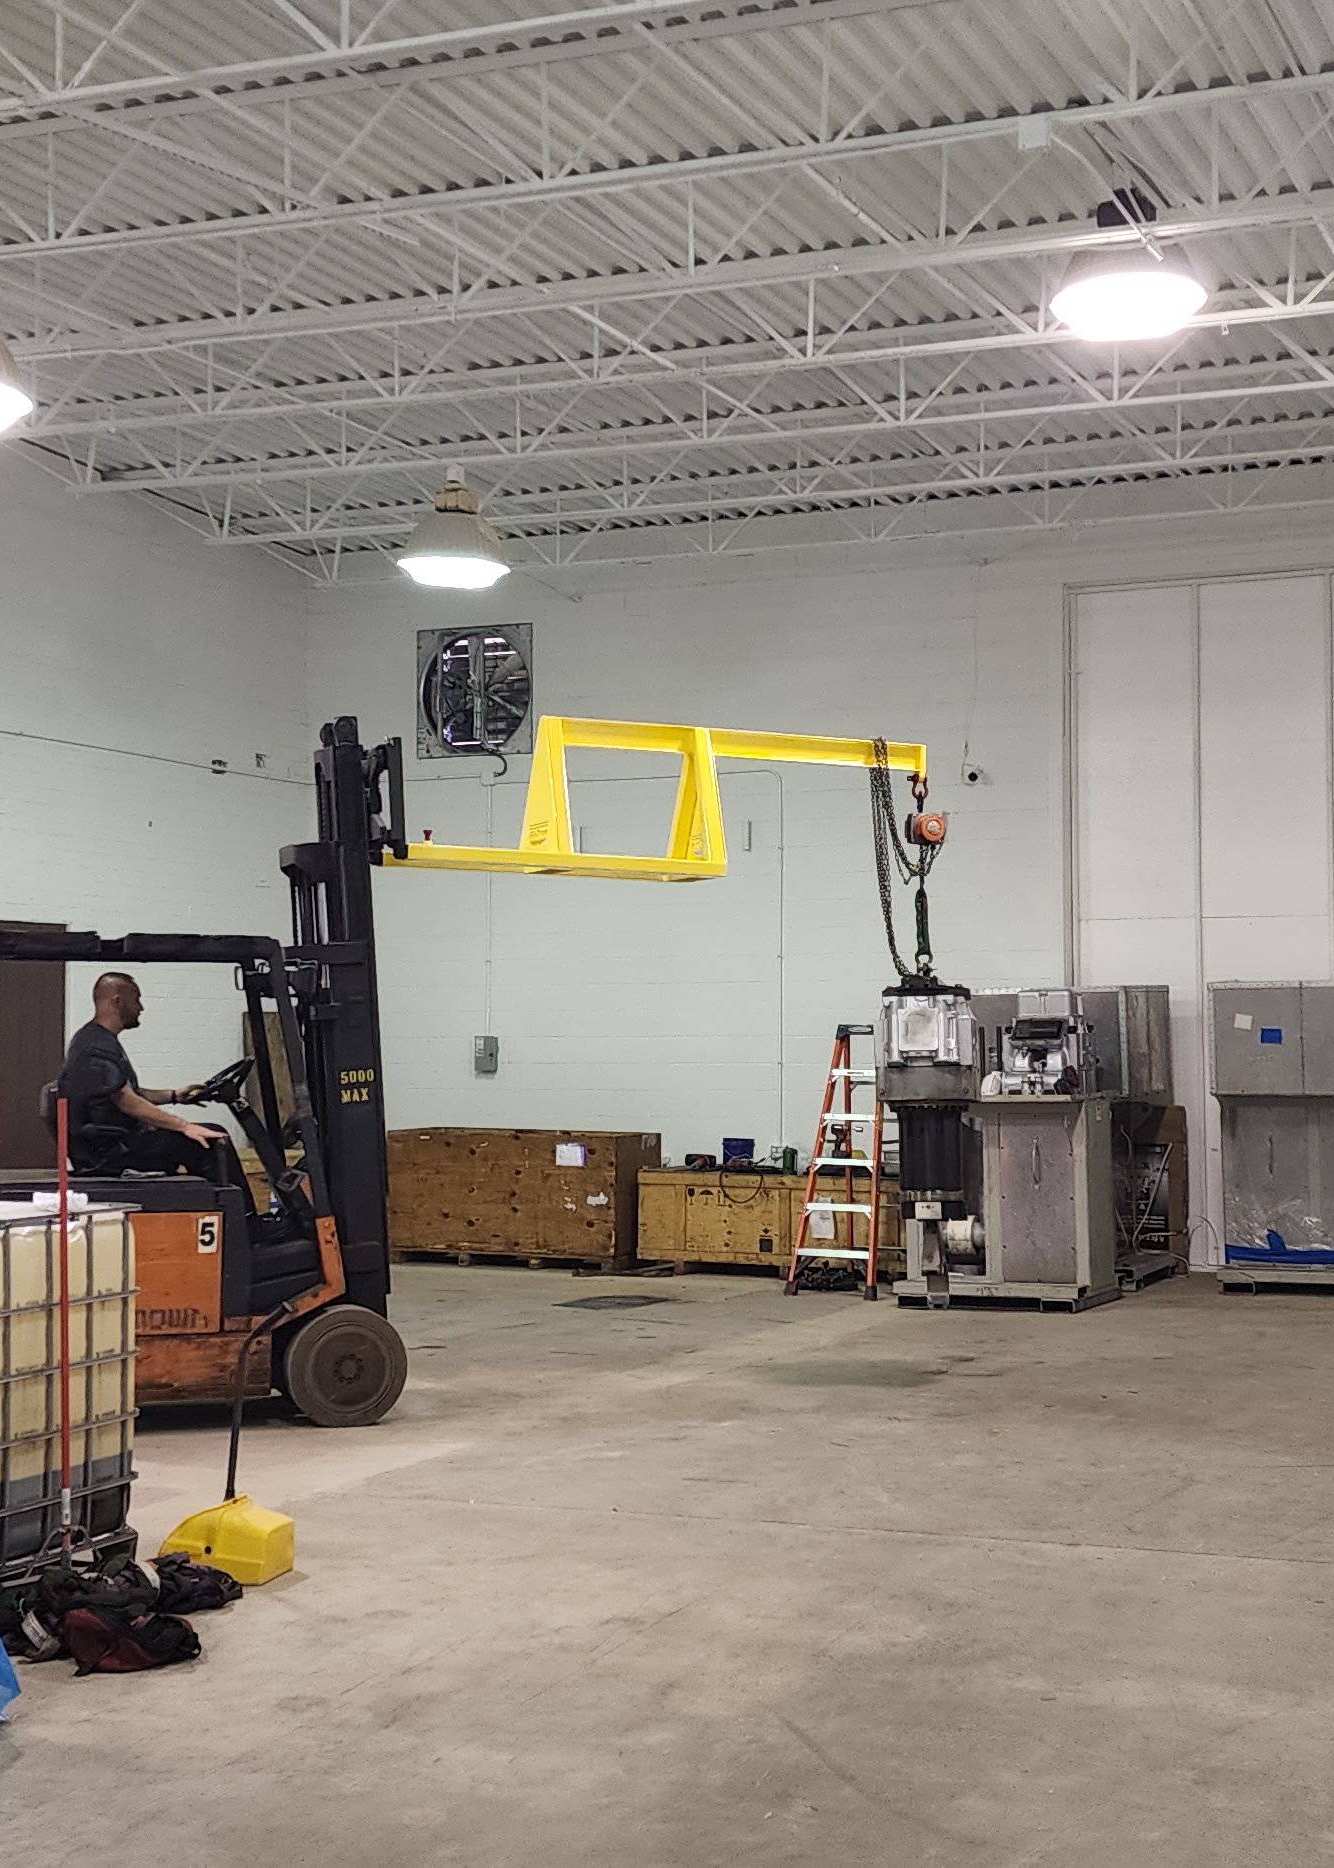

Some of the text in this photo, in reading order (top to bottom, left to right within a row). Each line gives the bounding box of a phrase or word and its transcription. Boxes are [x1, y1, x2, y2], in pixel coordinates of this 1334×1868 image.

[340, 1069, 375, 1085] 5000
[340, 1088, 370, 1104] MAX
[199, 1221, 216, 1247] 5
